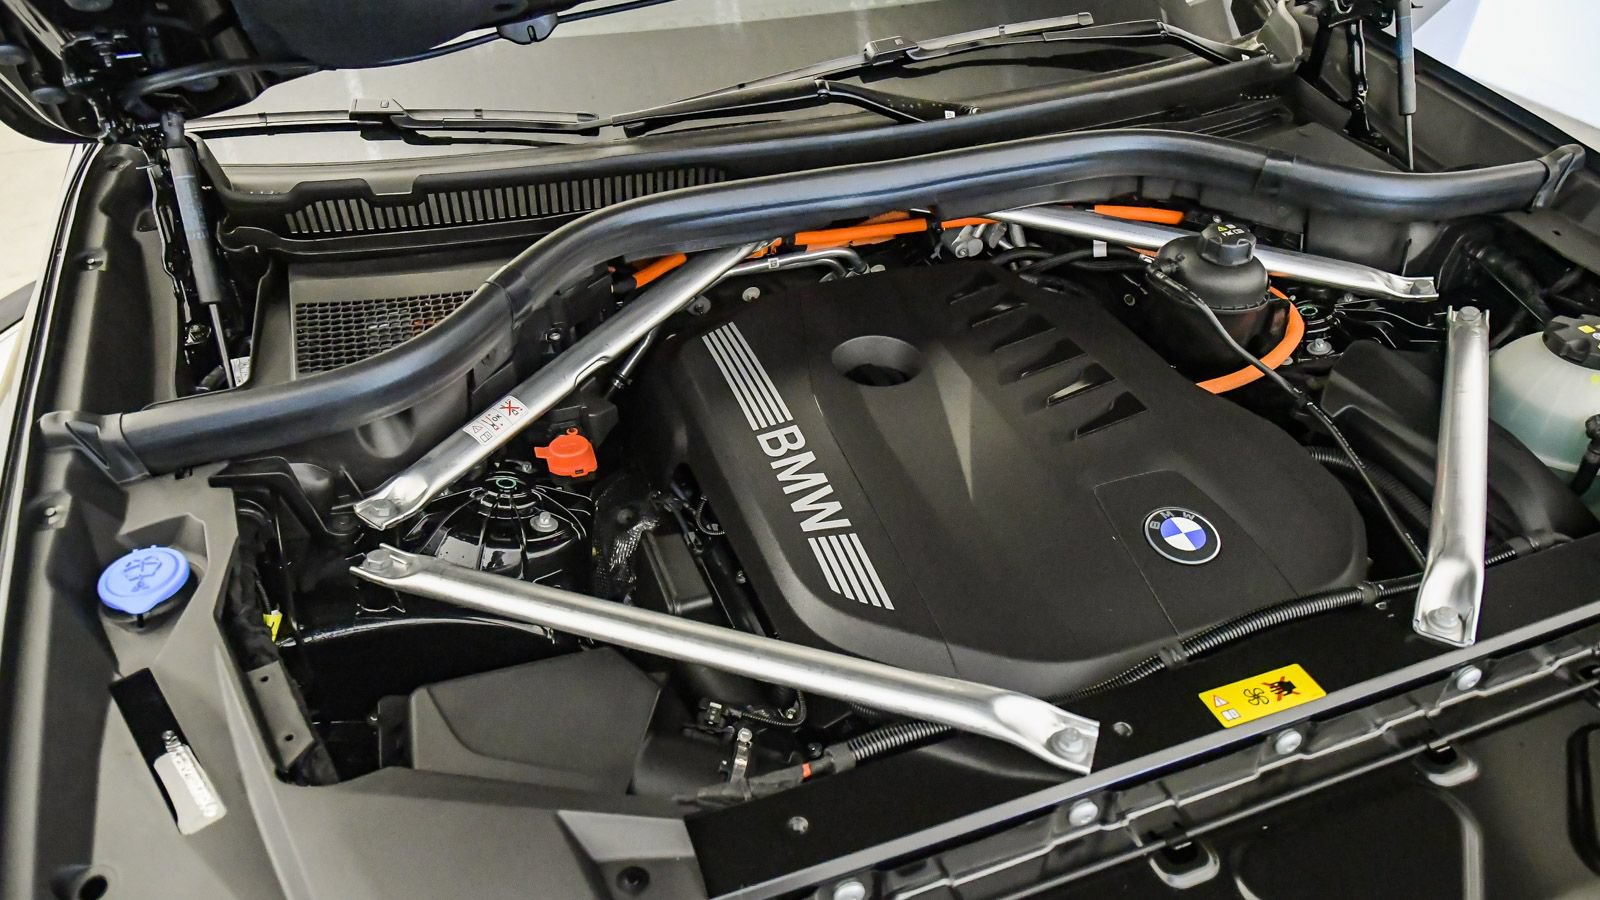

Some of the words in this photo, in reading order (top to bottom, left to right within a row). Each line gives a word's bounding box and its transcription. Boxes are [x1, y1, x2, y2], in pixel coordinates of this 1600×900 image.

[491, 414, 502, 422] OK
[756, 424, 852, 532] BMW
[1150, 510, 1195, 529] BMW
